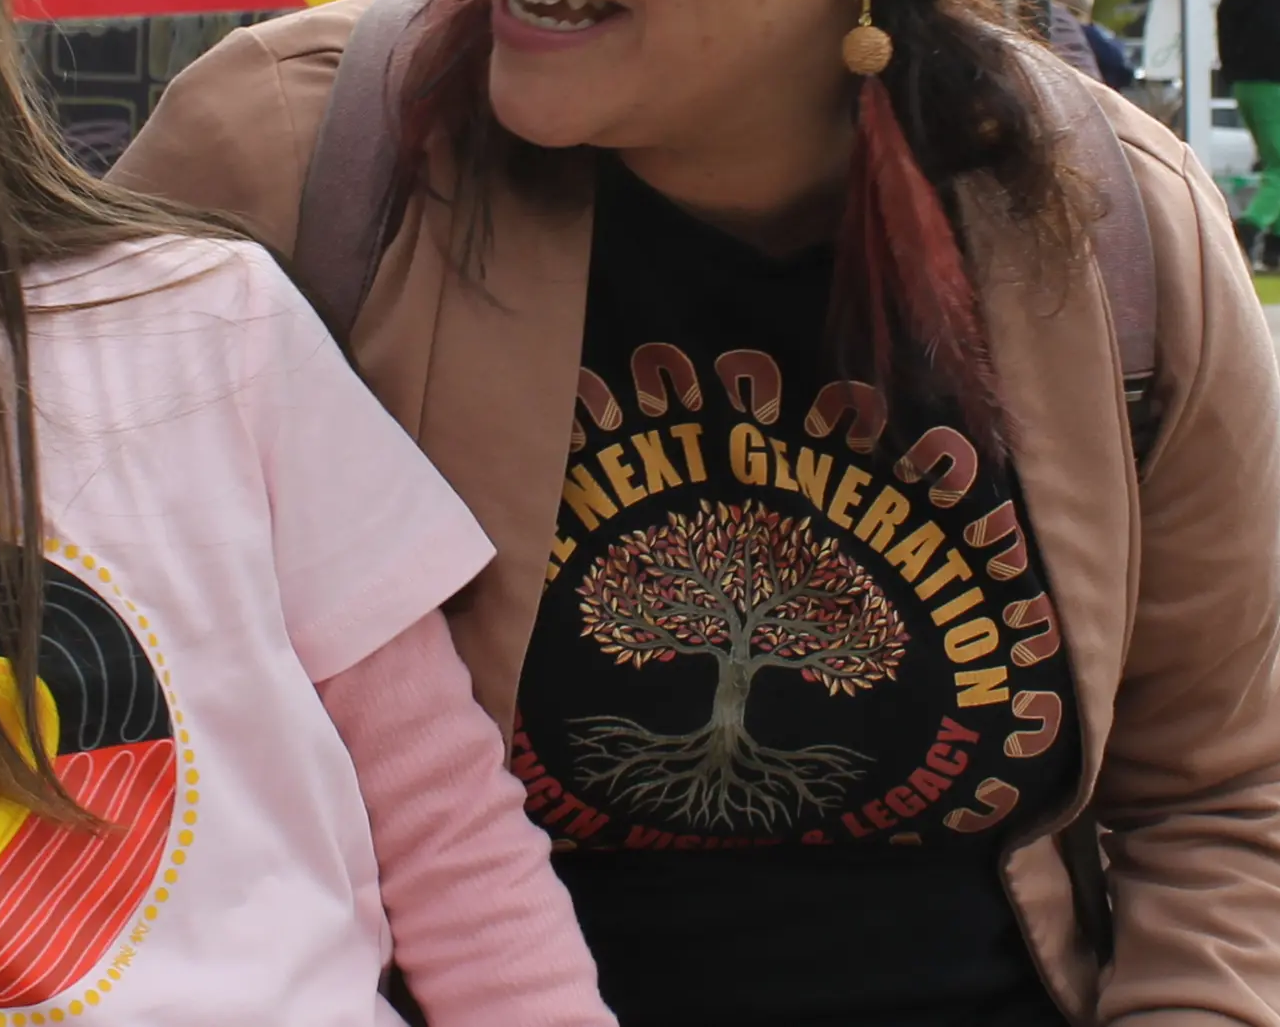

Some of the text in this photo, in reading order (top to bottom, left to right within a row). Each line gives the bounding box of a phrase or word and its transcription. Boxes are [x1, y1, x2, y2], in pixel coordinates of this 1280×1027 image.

[562, 422, 1010, 709] NEXT GENERATION
[840, 715, 981, 839] LEGACY
